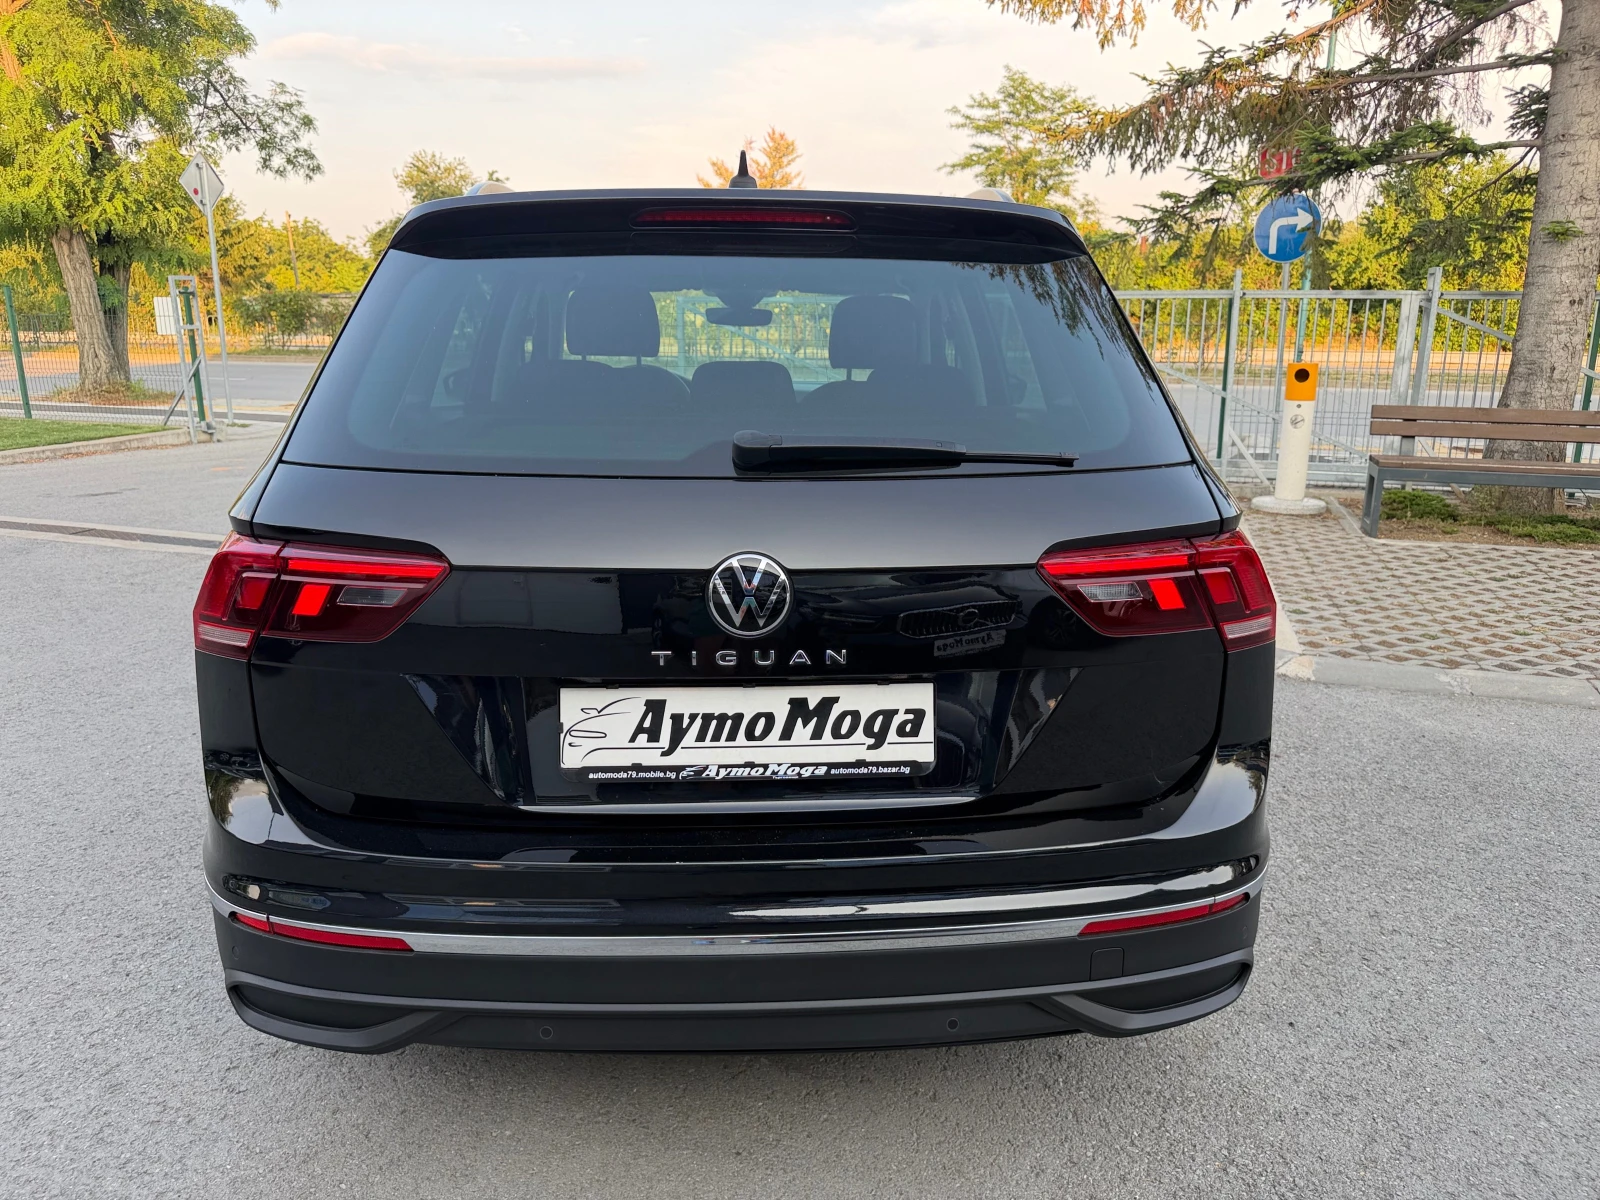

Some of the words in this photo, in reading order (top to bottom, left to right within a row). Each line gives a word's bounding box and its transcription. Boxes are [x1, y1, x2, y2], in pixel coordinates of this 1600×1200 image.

[651, 650, 847, 666] TIGUAN
[588, 770, 677, 779] automoda79.mobile.bg
[830, 765, 911, 774] automoda79.bazar.bg
